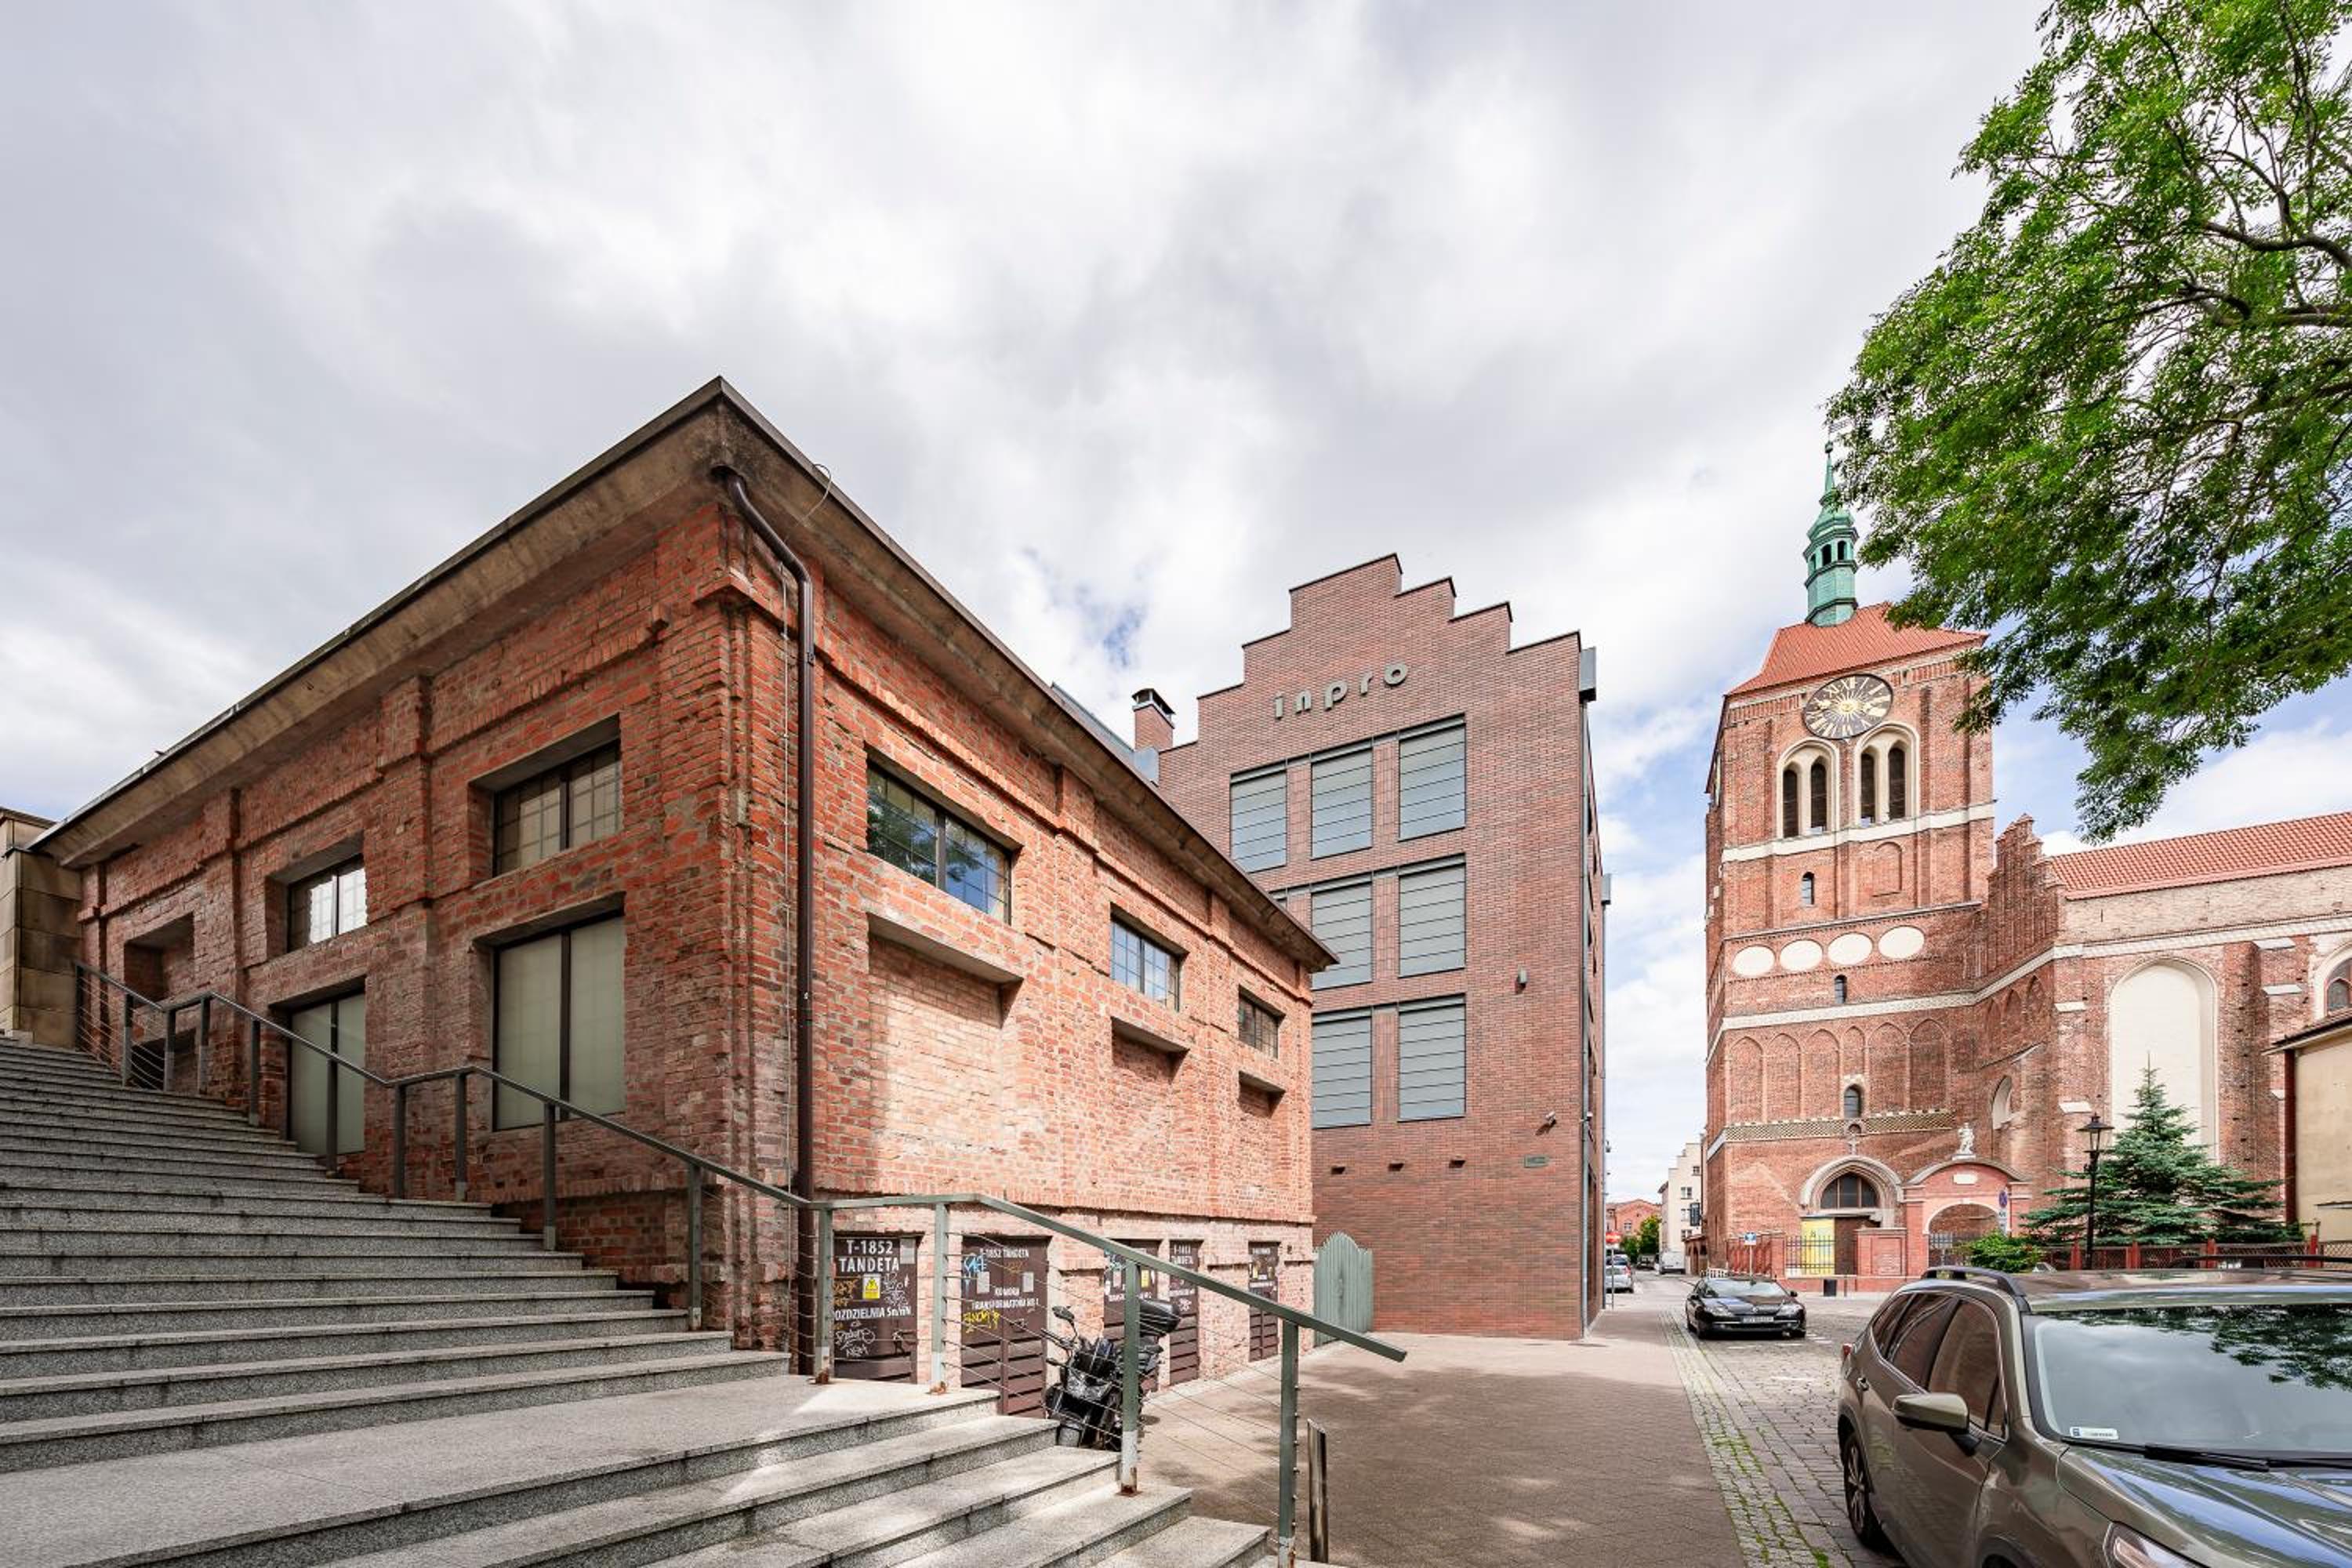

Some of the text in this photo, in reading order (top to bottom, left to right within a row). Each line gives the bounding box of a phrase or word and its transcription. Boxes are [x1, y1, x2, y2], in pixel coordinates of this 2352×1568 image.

[1275, 662, 1409, 720] inpro
[847, 1240, 893, 1255] T-1852
[838, 1257, 899, 1272] TANDETA
